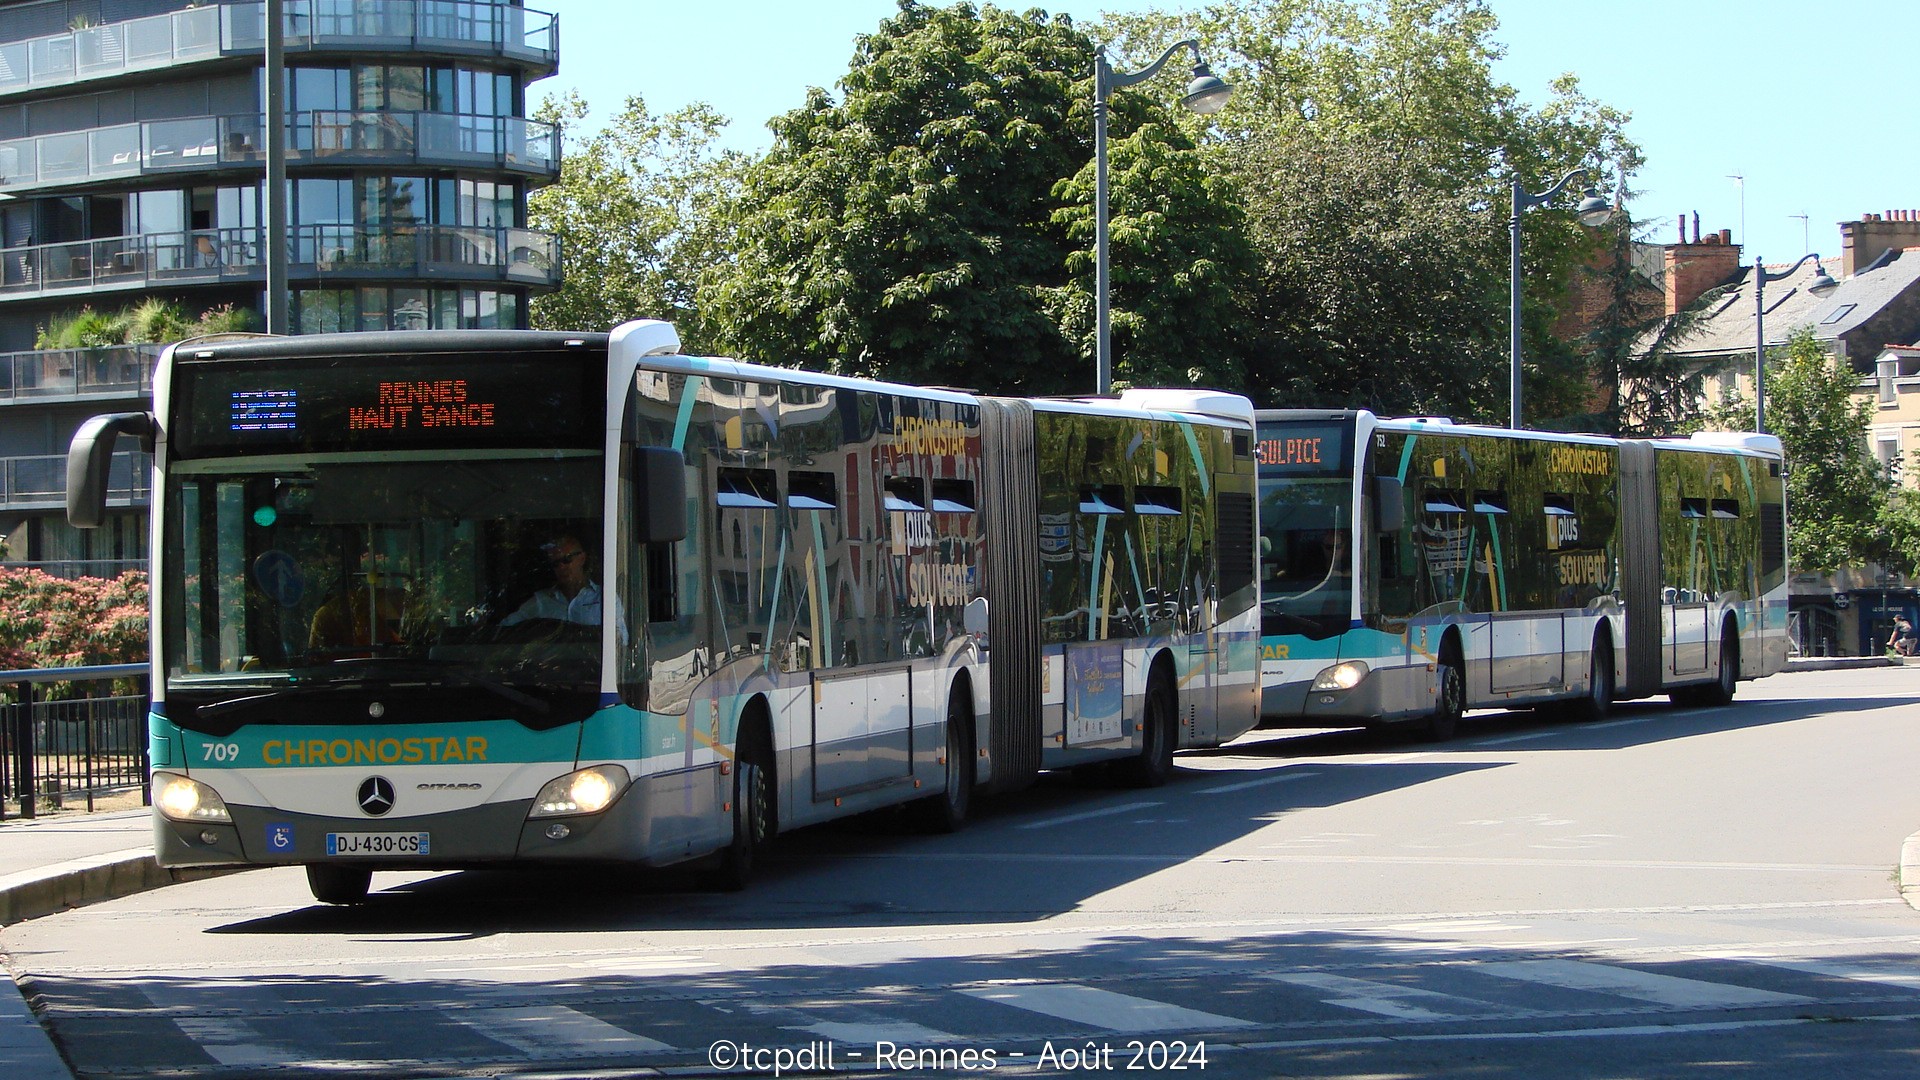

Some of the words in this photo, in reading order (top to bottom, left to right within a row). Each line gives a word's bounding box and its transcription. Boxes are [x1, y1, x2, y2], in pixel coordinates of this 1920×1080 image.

[380, 380, 467, 404] RENNES
[350, 406, 413, 429] HAUT
[421, 403, 494, 427] SANCE
[894, 415, 966, 457] CHRONOSTAR
[1259, 438, 1321, 464] SULPICE
[1551, 447, 1608, 475] CHRONOSTAR
[906, 512, 932, 556] plus
[1558, 514, 1578, 546] plus
[910, 554, 969, 607] souvent
[1560, 549, 1607, 585] souvent
[202, 743, 239, 762] 709
[262, 736, 488, 765] CHRONOSTAR
[337, 836, 419, 852] DJ-430-CS
